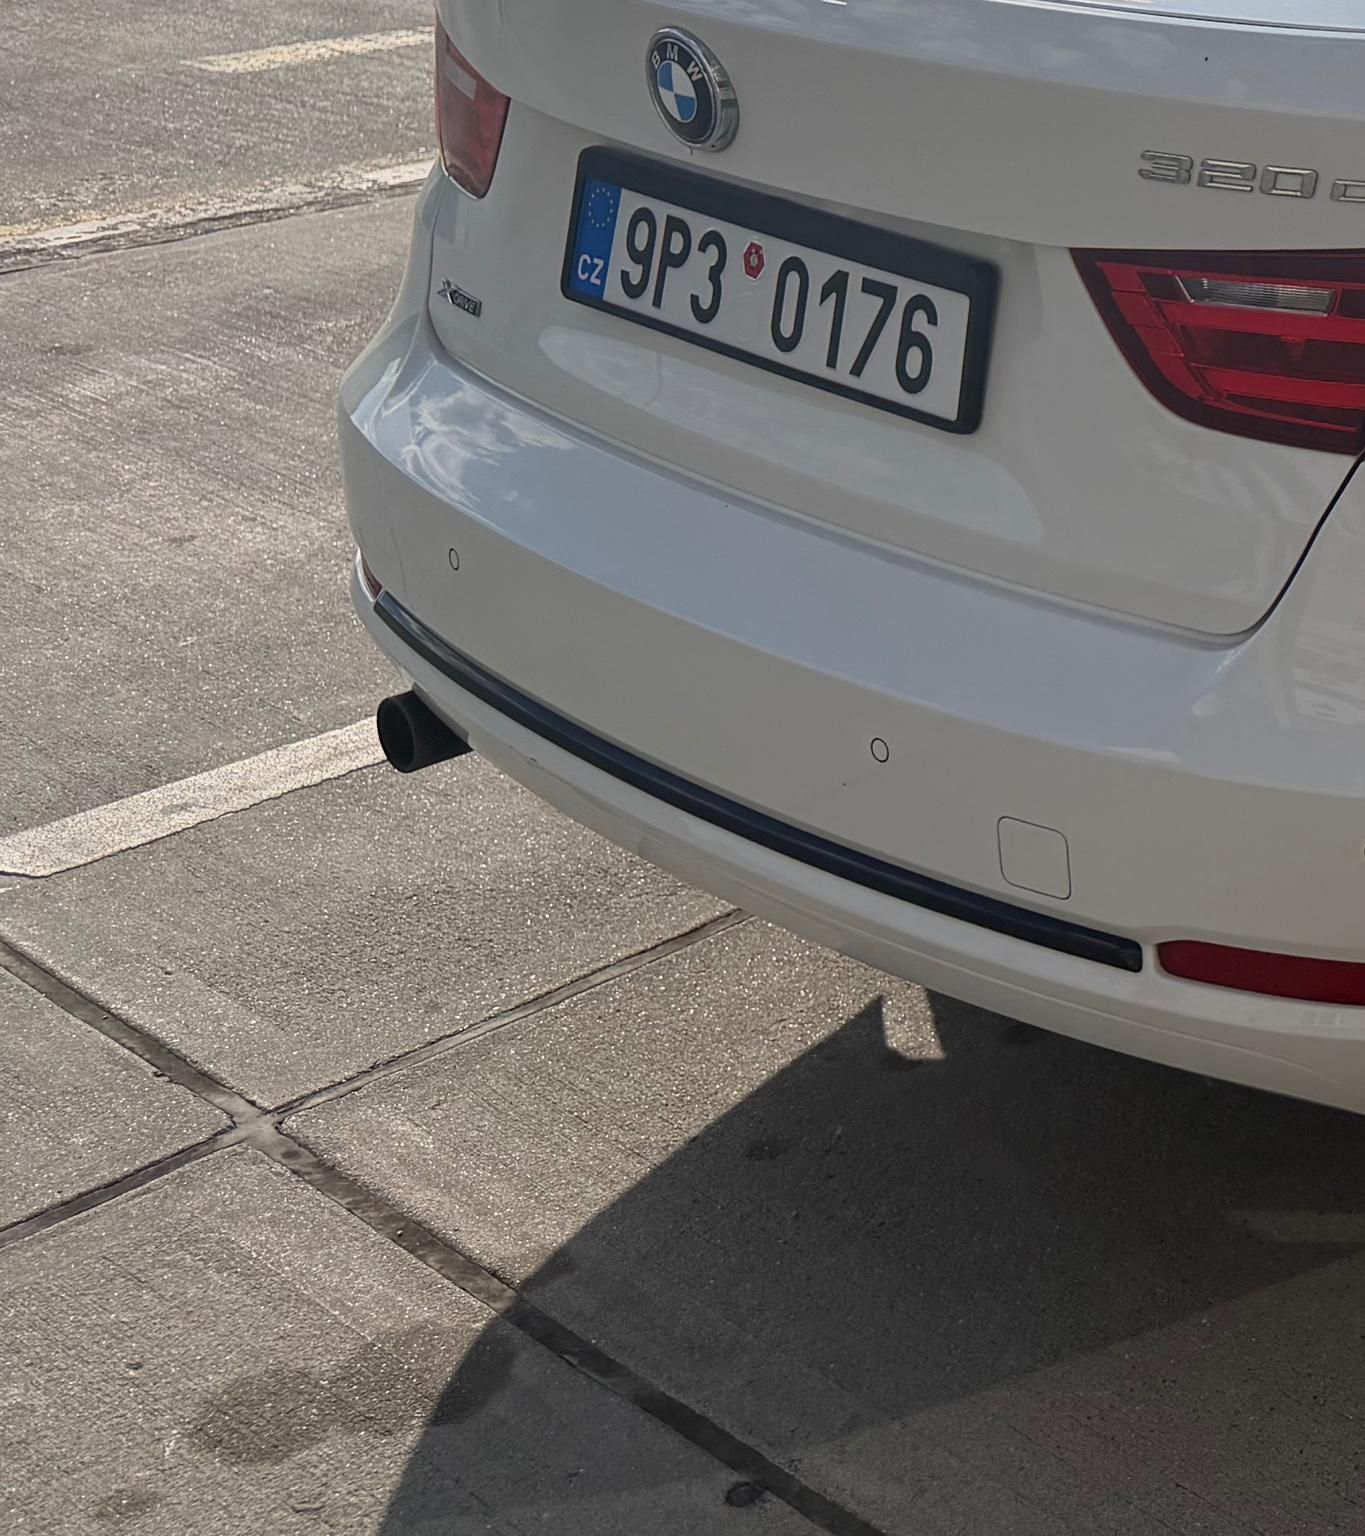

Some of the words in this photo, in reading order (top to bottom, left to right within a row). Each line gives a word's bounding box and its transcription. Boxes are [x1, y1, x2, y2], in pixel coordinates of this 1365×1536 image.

[651, 43, 703, 81] BMW
[577, 253, 606, 286] CZ
[620, 207, 727, 323] 9P3
[771, 255, 938, 394] 0176
